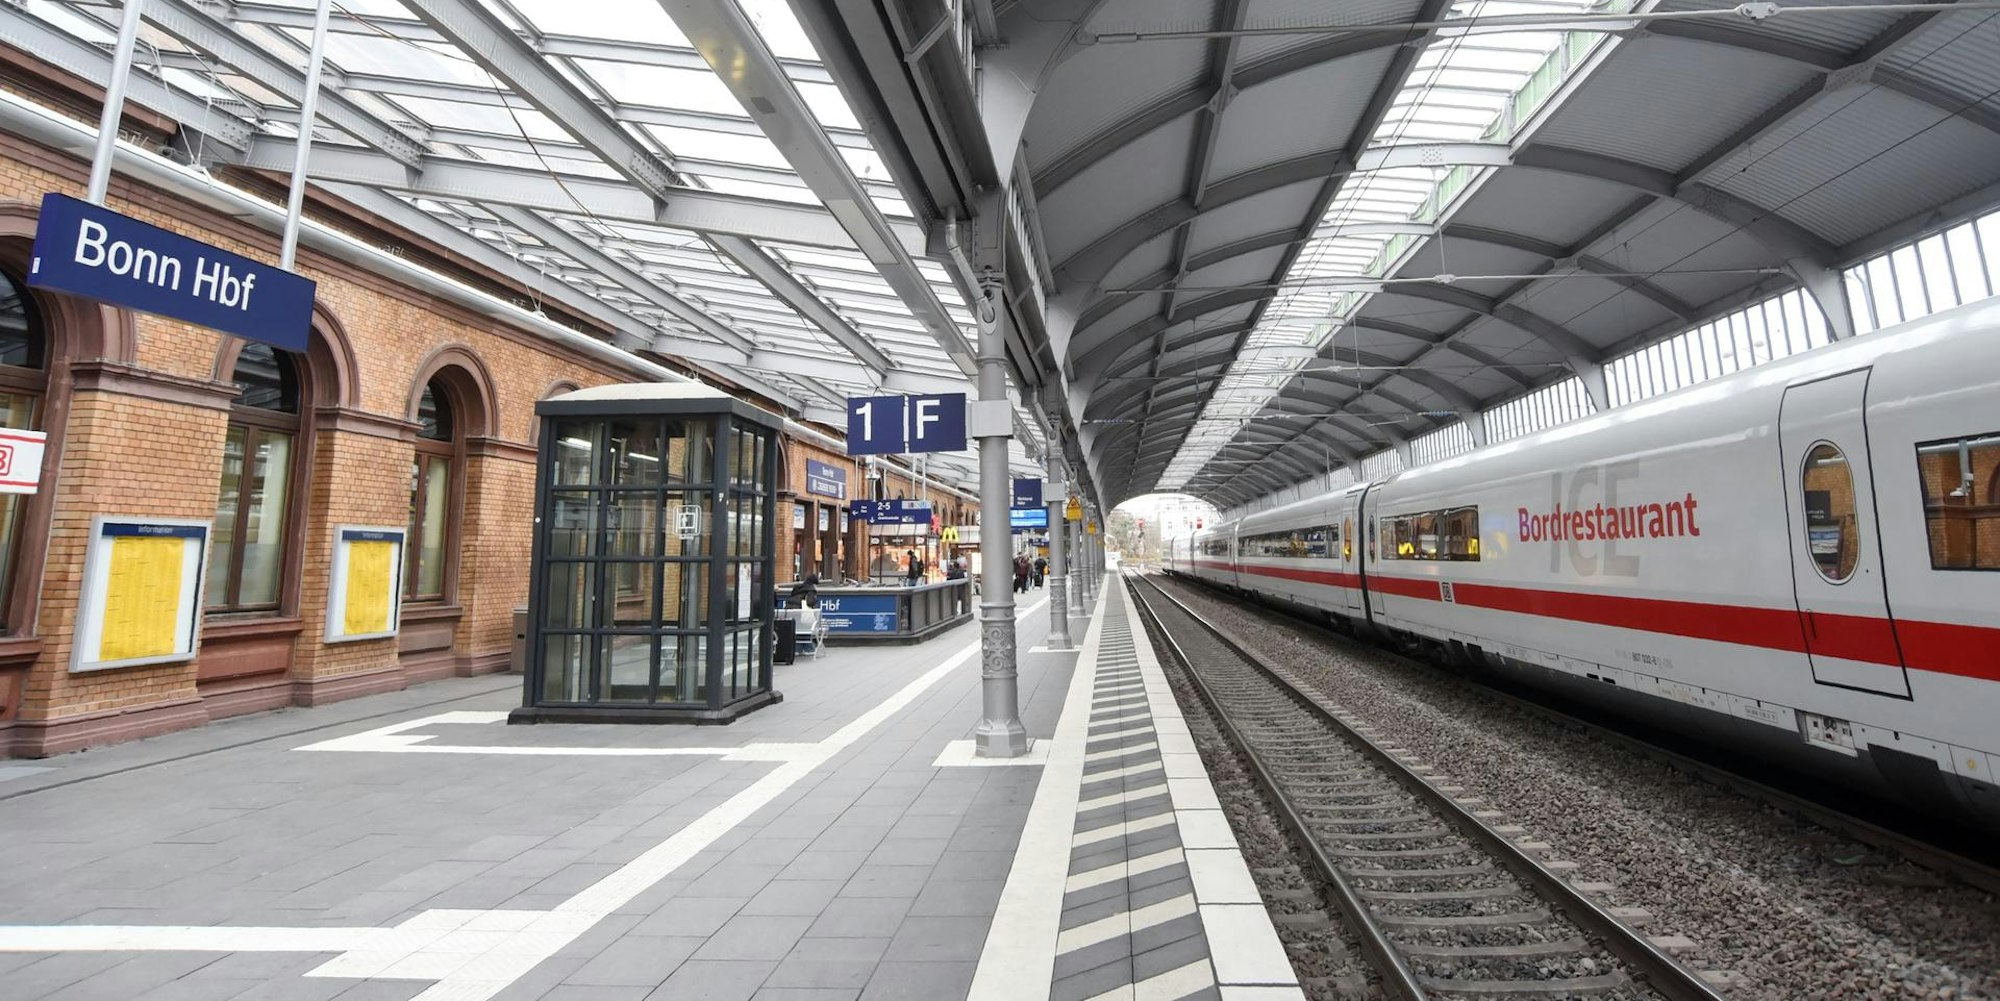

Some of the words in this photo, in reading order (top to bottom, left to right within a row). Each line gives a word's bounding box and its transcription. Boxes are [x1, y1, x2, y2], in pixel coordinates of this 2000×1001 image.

[74, 218, 182, 291] Bonn
[192, 257, 256, 312] Hbf
[855, 401, 872, 441] 1
[916, 399, 940, 440] F
[877, 501, 891, 511] 2-5
[1518, 493, 1700, 543] Bordrestaurant
[1550, 458, 1640, 577] ICE
[820, 599, 841, 611] Hbf
